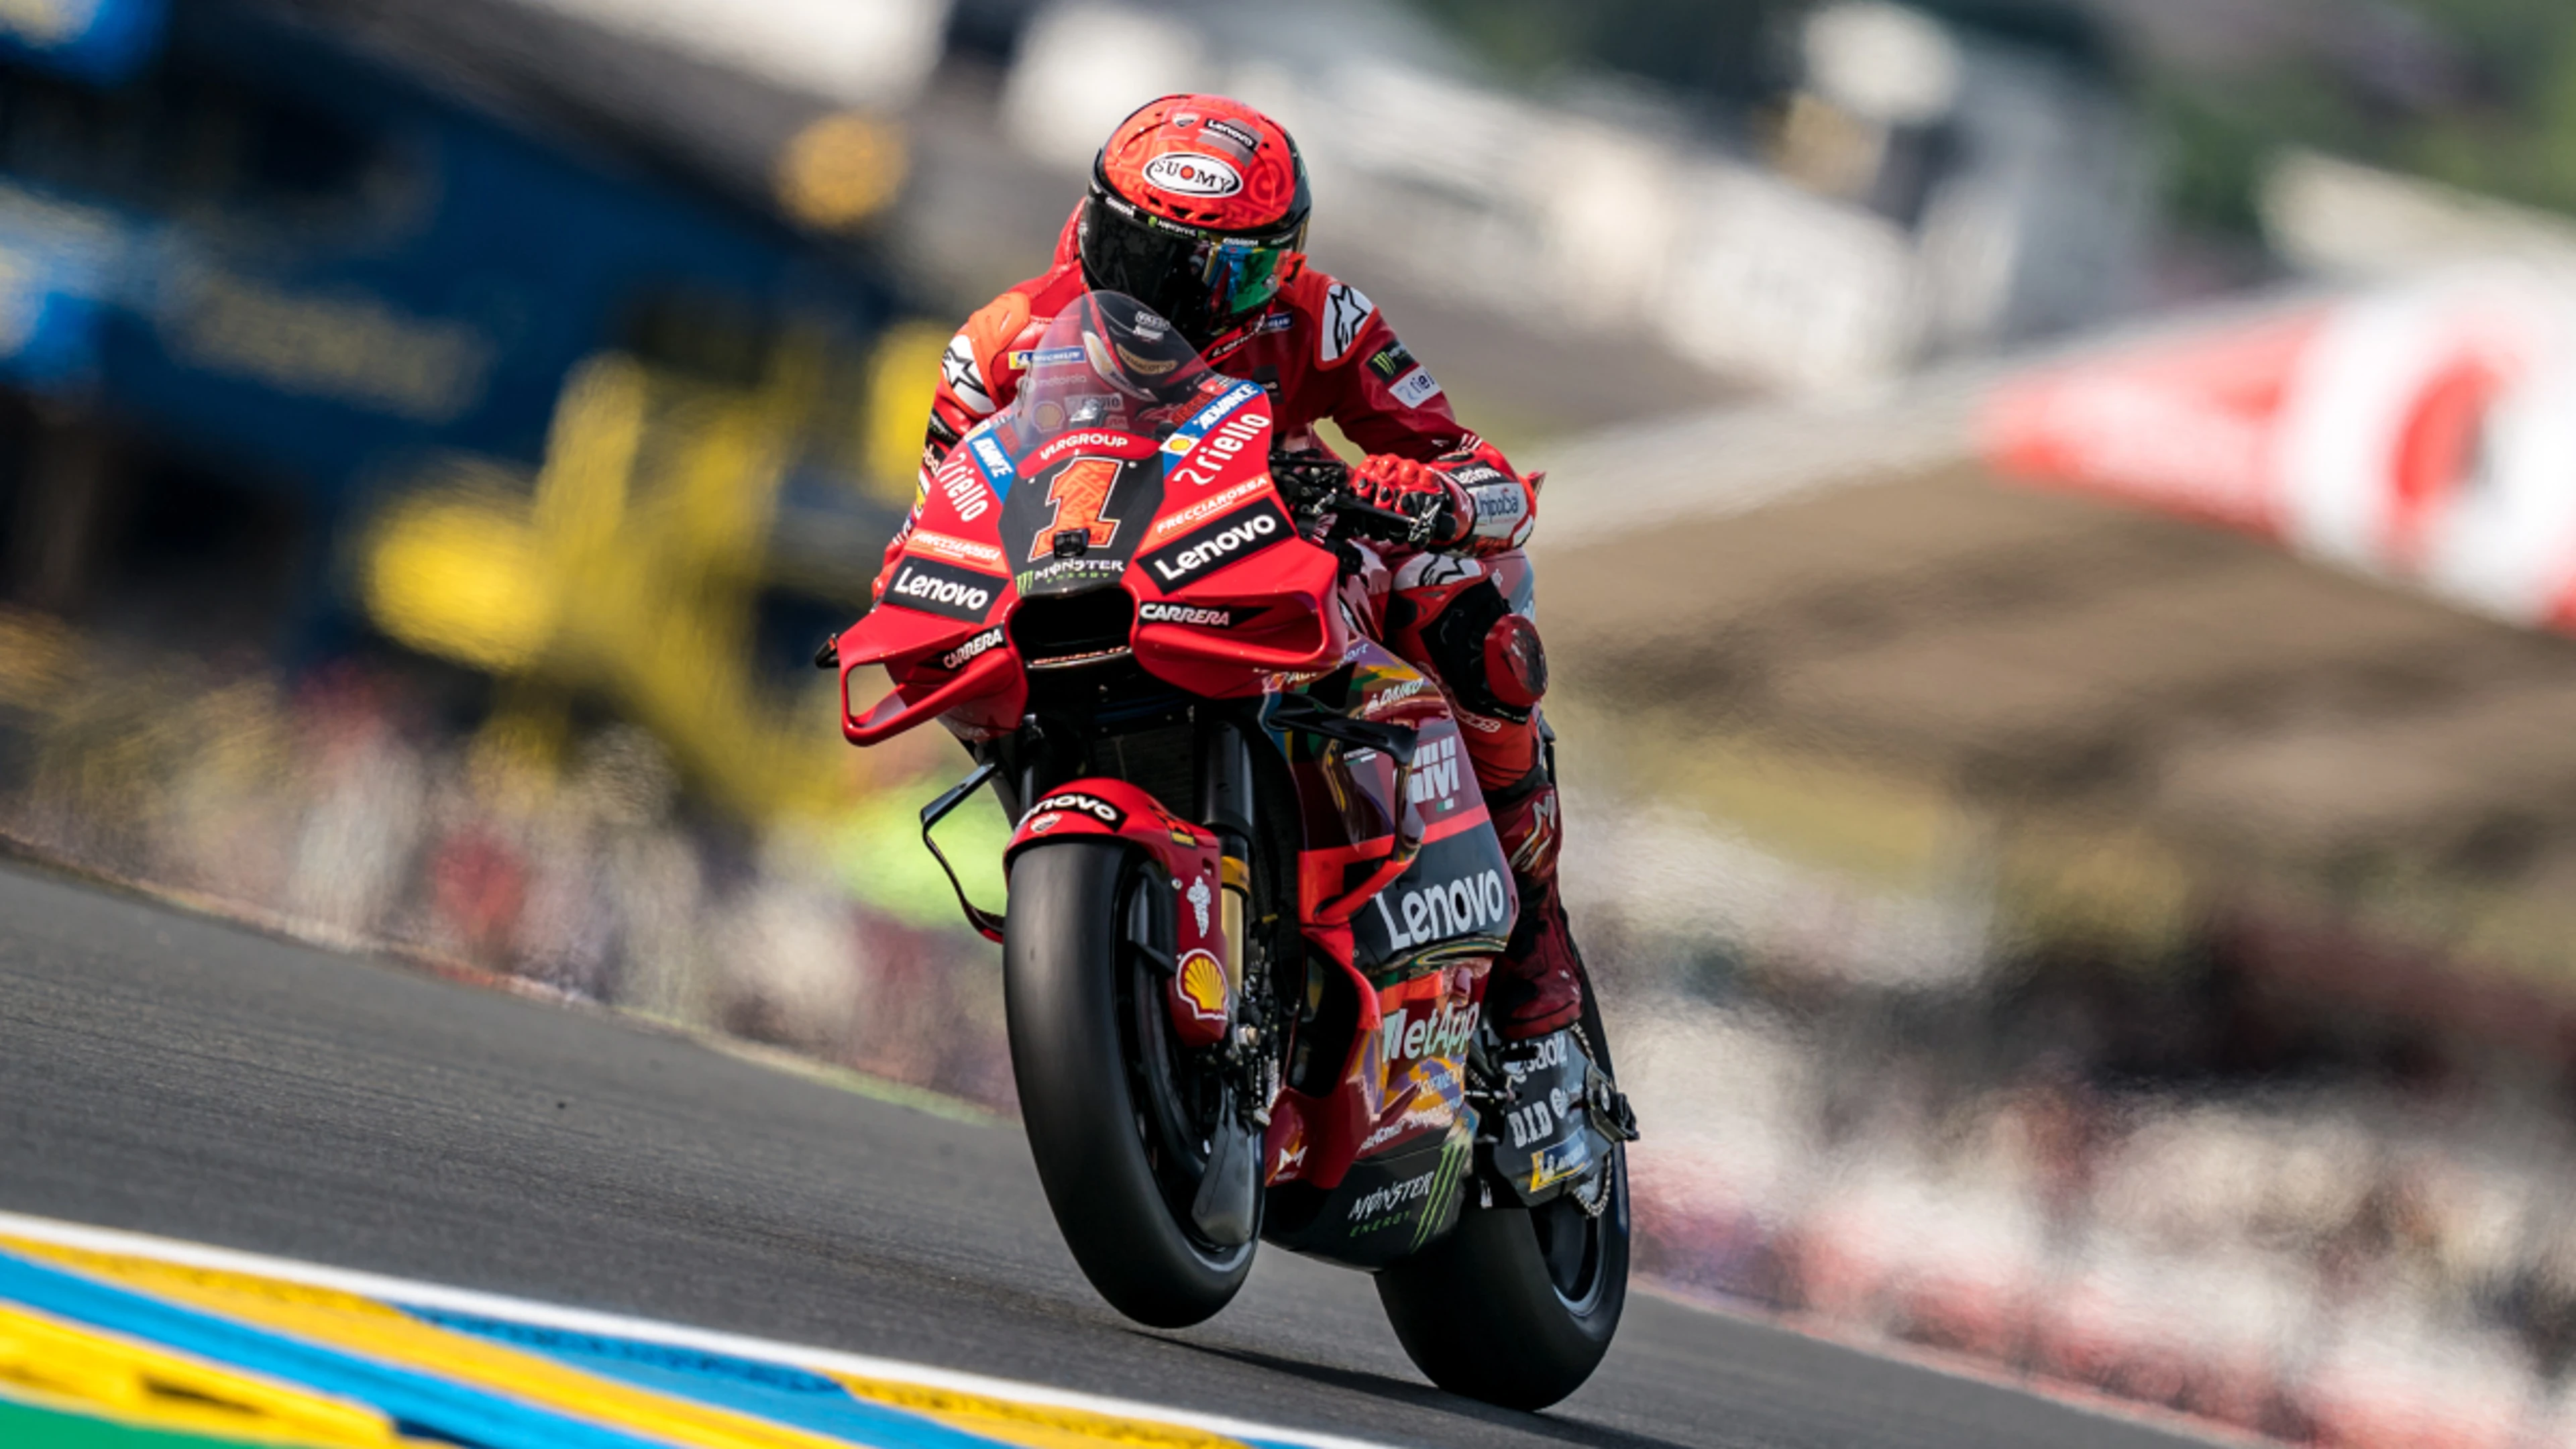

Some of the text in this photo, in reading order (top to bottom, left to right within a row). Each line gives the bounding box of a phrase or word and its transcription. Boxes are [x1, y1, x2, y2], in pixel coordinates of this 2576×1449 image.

[1153, 159, 1232, 193] SUOMY
[1027, 457, 1124, 564] 1
[1157, 477, 1267, 535] FRECCIAROSSA
[1034, 557, 1125, 580] MONSTER
[1154, 515, 1276, 581] Lenovo
[894, 566, 989, 610] Lenovo
[1140, 604, 1230, 627] CARRERA
[943, 629, 1004, 669] CARRERA
[1373, 869, 1503, 951] Lenovo
[1383, 1002, 1480, 1063] NetApp
[1348, 1170, 1435, 1220] MONSTER
